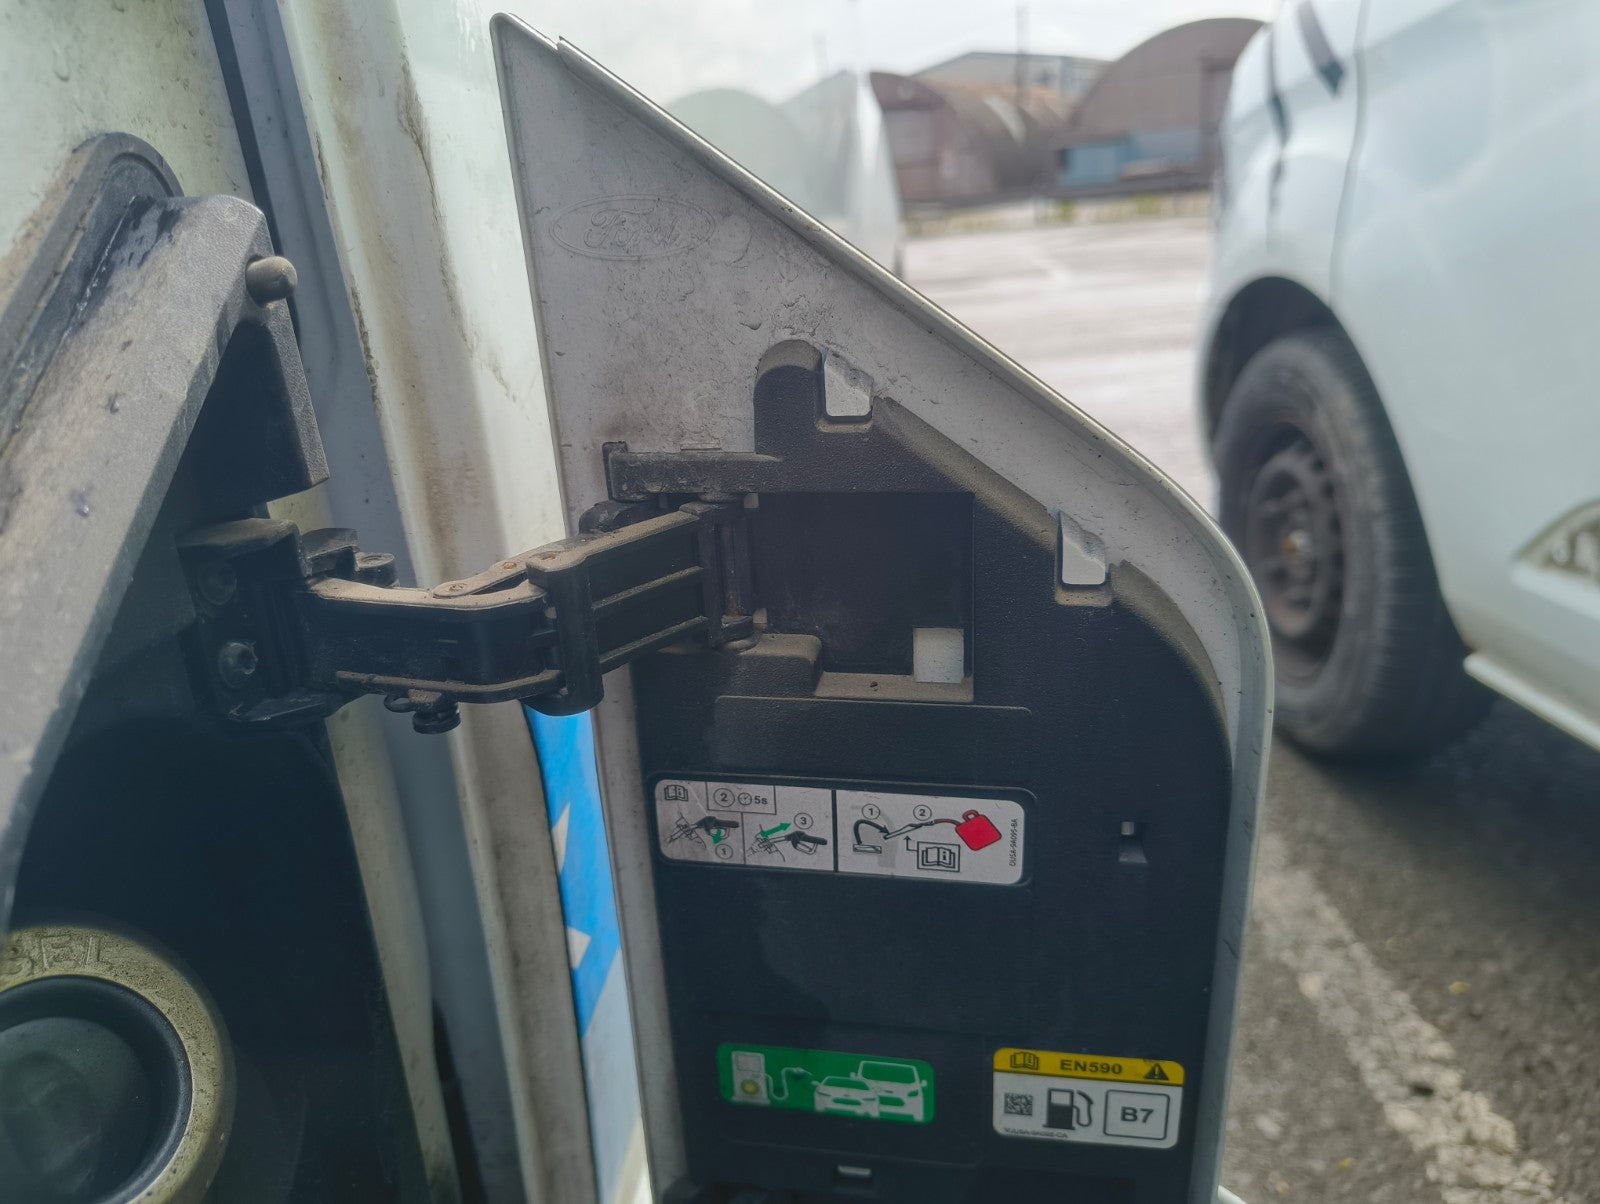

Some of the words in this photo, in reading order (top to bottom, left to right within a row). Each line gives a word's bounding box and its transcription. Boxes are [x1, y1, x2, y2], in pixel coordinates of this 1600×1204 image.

[583, 207, 679, 249] Ford
[753, 795, 769, 805] 5s
[1060, 1058, 1123, 1075] EN590
[1120, 1105, 1154, 1124] B7
